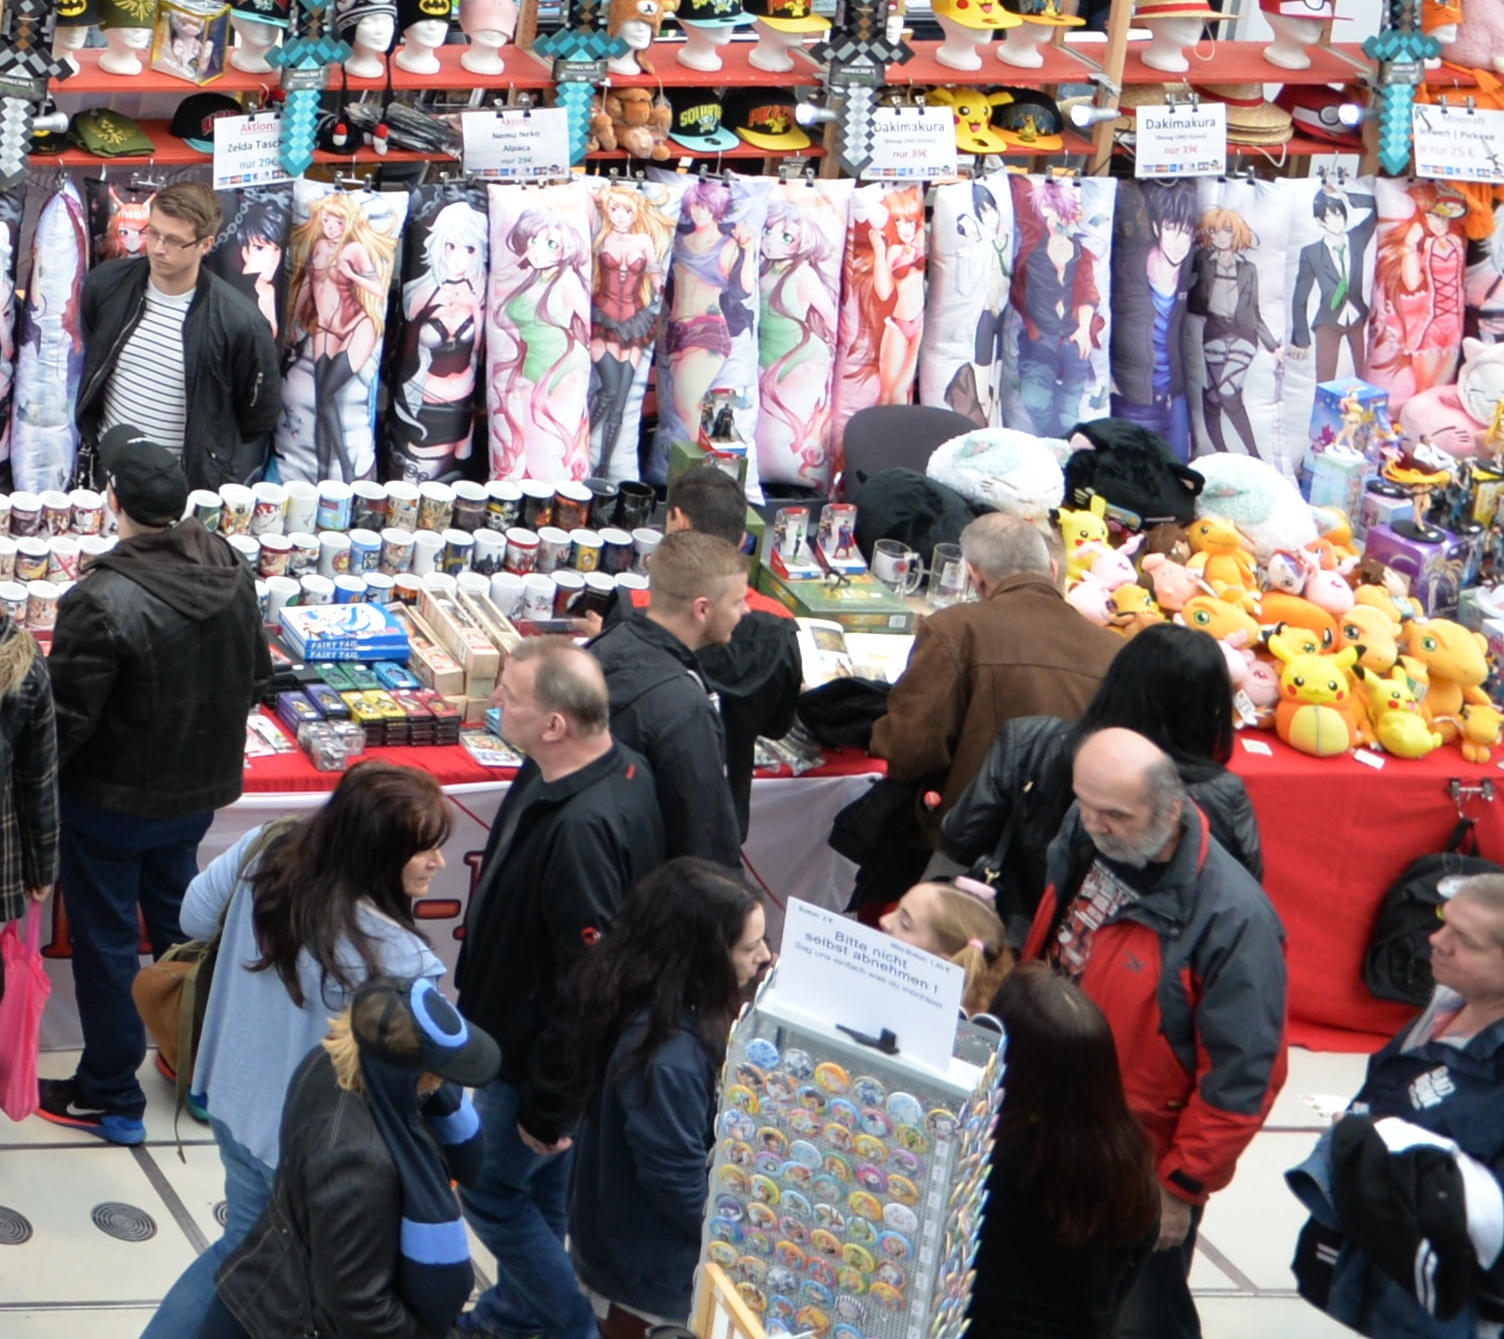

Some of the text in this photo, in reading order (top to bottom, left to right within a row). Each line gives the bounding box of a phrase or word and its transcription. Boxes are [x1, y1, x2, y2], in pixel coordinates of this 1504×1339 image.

[240, 120, 277, 135] Aktion:
[873, 119, 946, 134] Dakimakura
[1145, 115, 1217, 131] Dakimakura
[492, 129, 541, 140] Nemu Neko
[226, 141, 254, 155] Zelda
[502, 143, 531, 155] Alpaca
[892, 148, 928, 160] nur 39€
[1164, 144, 1199, 156] nur 39€
[1450, 145, 1465, 158] 25
[1468, 146, 1475, 158] €
[239, 156, 278, 171] nur 29€
[310, 640, 359, 650] FAIRY TAIL
[309, 650, 359, 660] FAIRY TAIL
[834, 930, 908, 971] Bitte nicht
[794, 940, 901, 990] Sag uns einfach was du
[804, 931, 929, 991] selbst abnehmen
